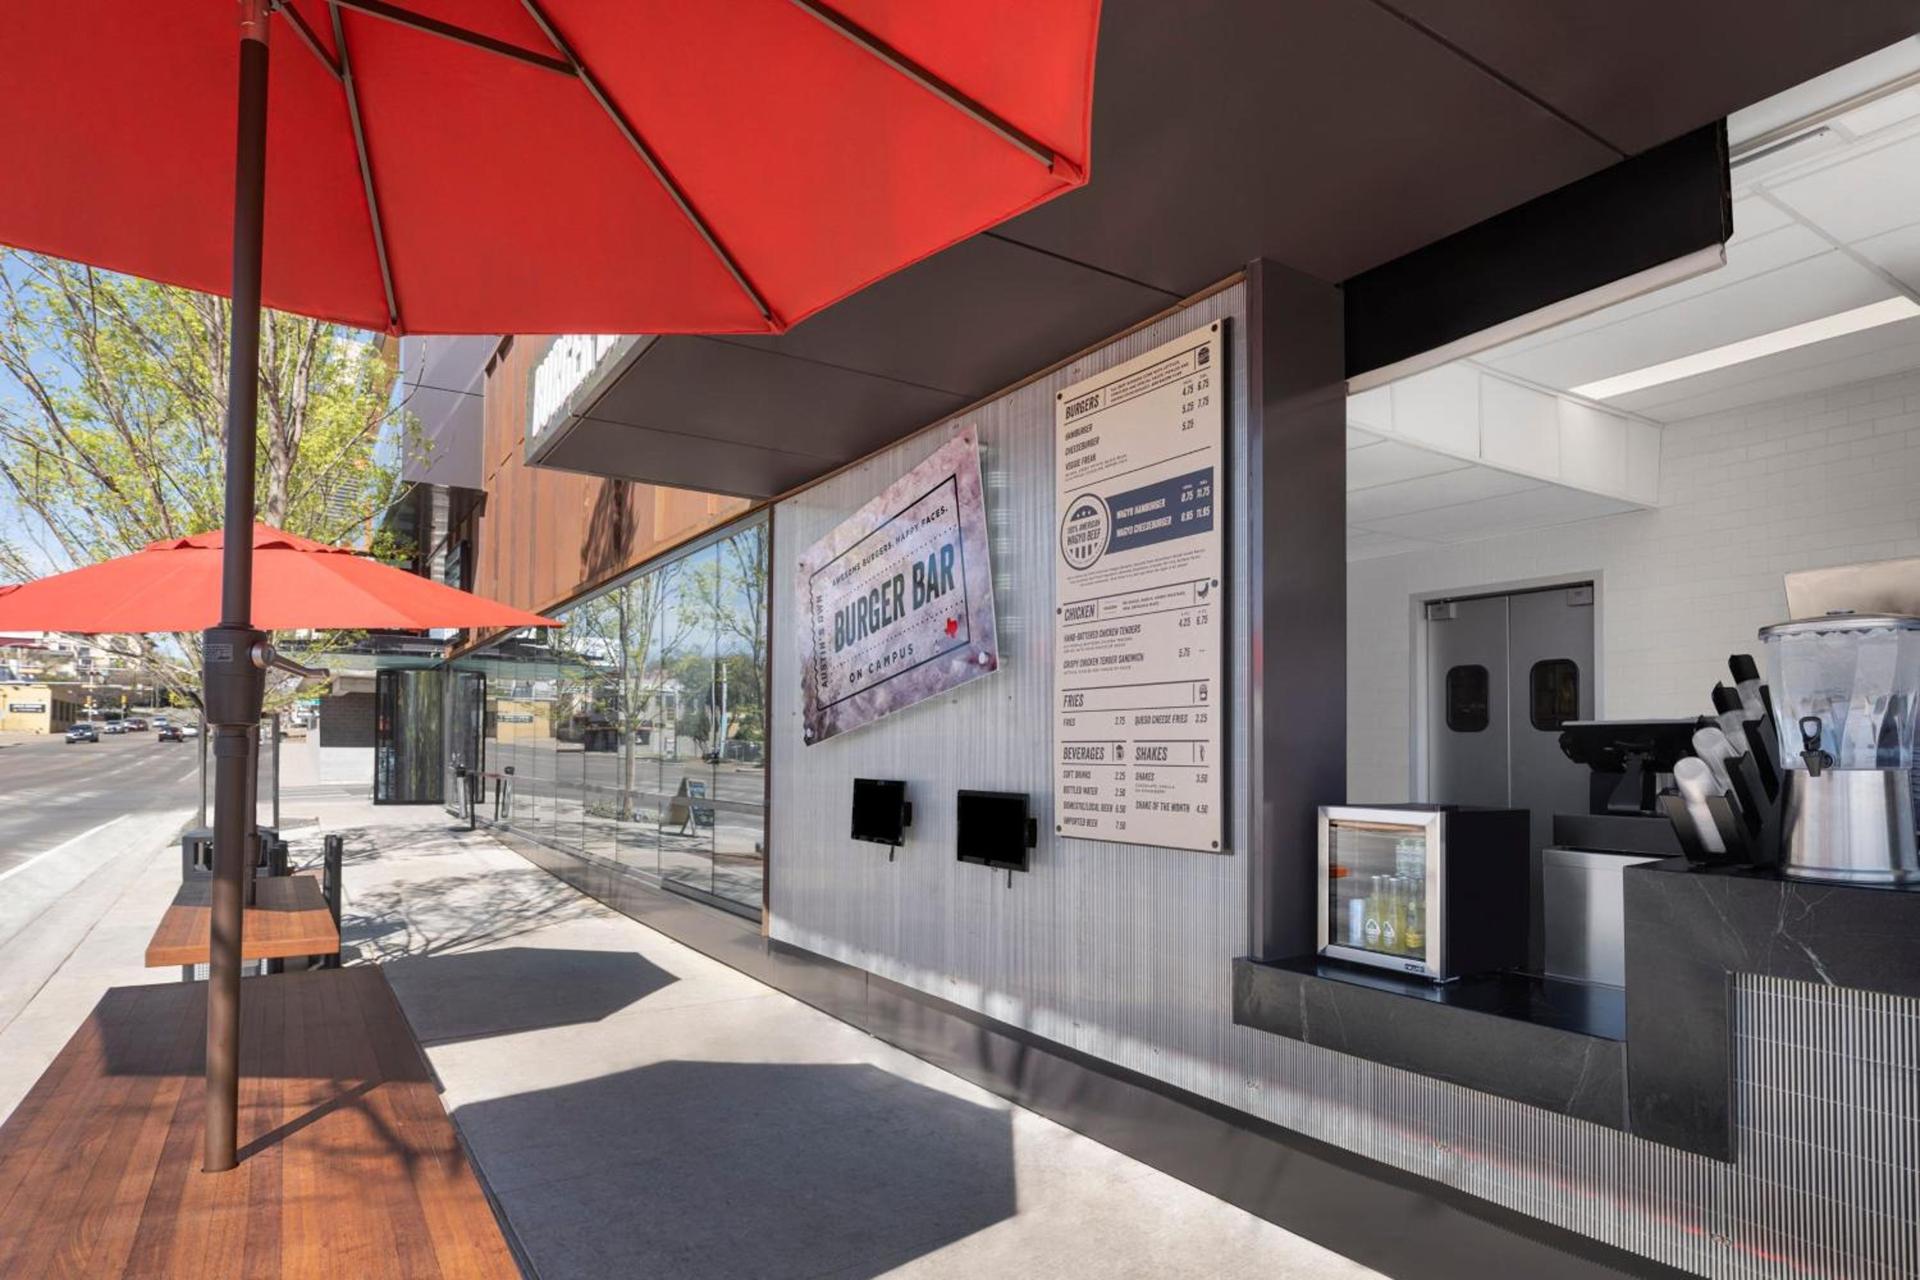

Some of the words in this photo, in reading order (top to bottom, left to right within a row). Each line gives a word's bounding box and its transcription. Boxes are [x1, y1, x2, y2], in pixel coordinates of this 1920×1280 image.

[1065, 394, 1099, 419] BURGERS
[1065, 423, 1093, 441] HAMBURGER
[1065, 436, 1100, 456] CHEESEBURGER
[1067, 532, 1086, 546] WAGYU
[1087, 527, 1101, 542] BEEF
[832, 562, 861, 586] AWESOME
[895, 522, 919, 544] HAPPY
[921, 505, 948, 526] FACES.
[834, 572, 906, 654] BURGER
[912, 543, 955, 611] BAR
[816, 594, 824, 624] OWN
[1064, 604, 1096, 622] CHICKEN
[1099, 627, 1119, 638] CHICKEN
[1119, 624, 1142, 635] TENDERS
[818, 628, 829, 688] AUSTIN'S
[849, 668, 863, 684] ON
[868, 643, 914, 674] CAMPUS
[1080, 657, 1099, 667] CHICKEN
[1119, 653, 1144, 663] SANDWICH
[1063, 694, 1084, 708] FRIES
[1063, 717, 1076, 726] FRIES
[1172, 714, 1188, 724] FRIES
[1063, 747, 1105, 760] BEVERAGES
[1135, 747, 1168, 761] SHAKES
[1100, 802, 1113, 812] BEER
[1152, 801, 1159, 810] OF
[1160, 802, 1170, 811] THE
[1171, 803, 1190, 813] MONTH
[1086, 818, 1098, 827] BEER
